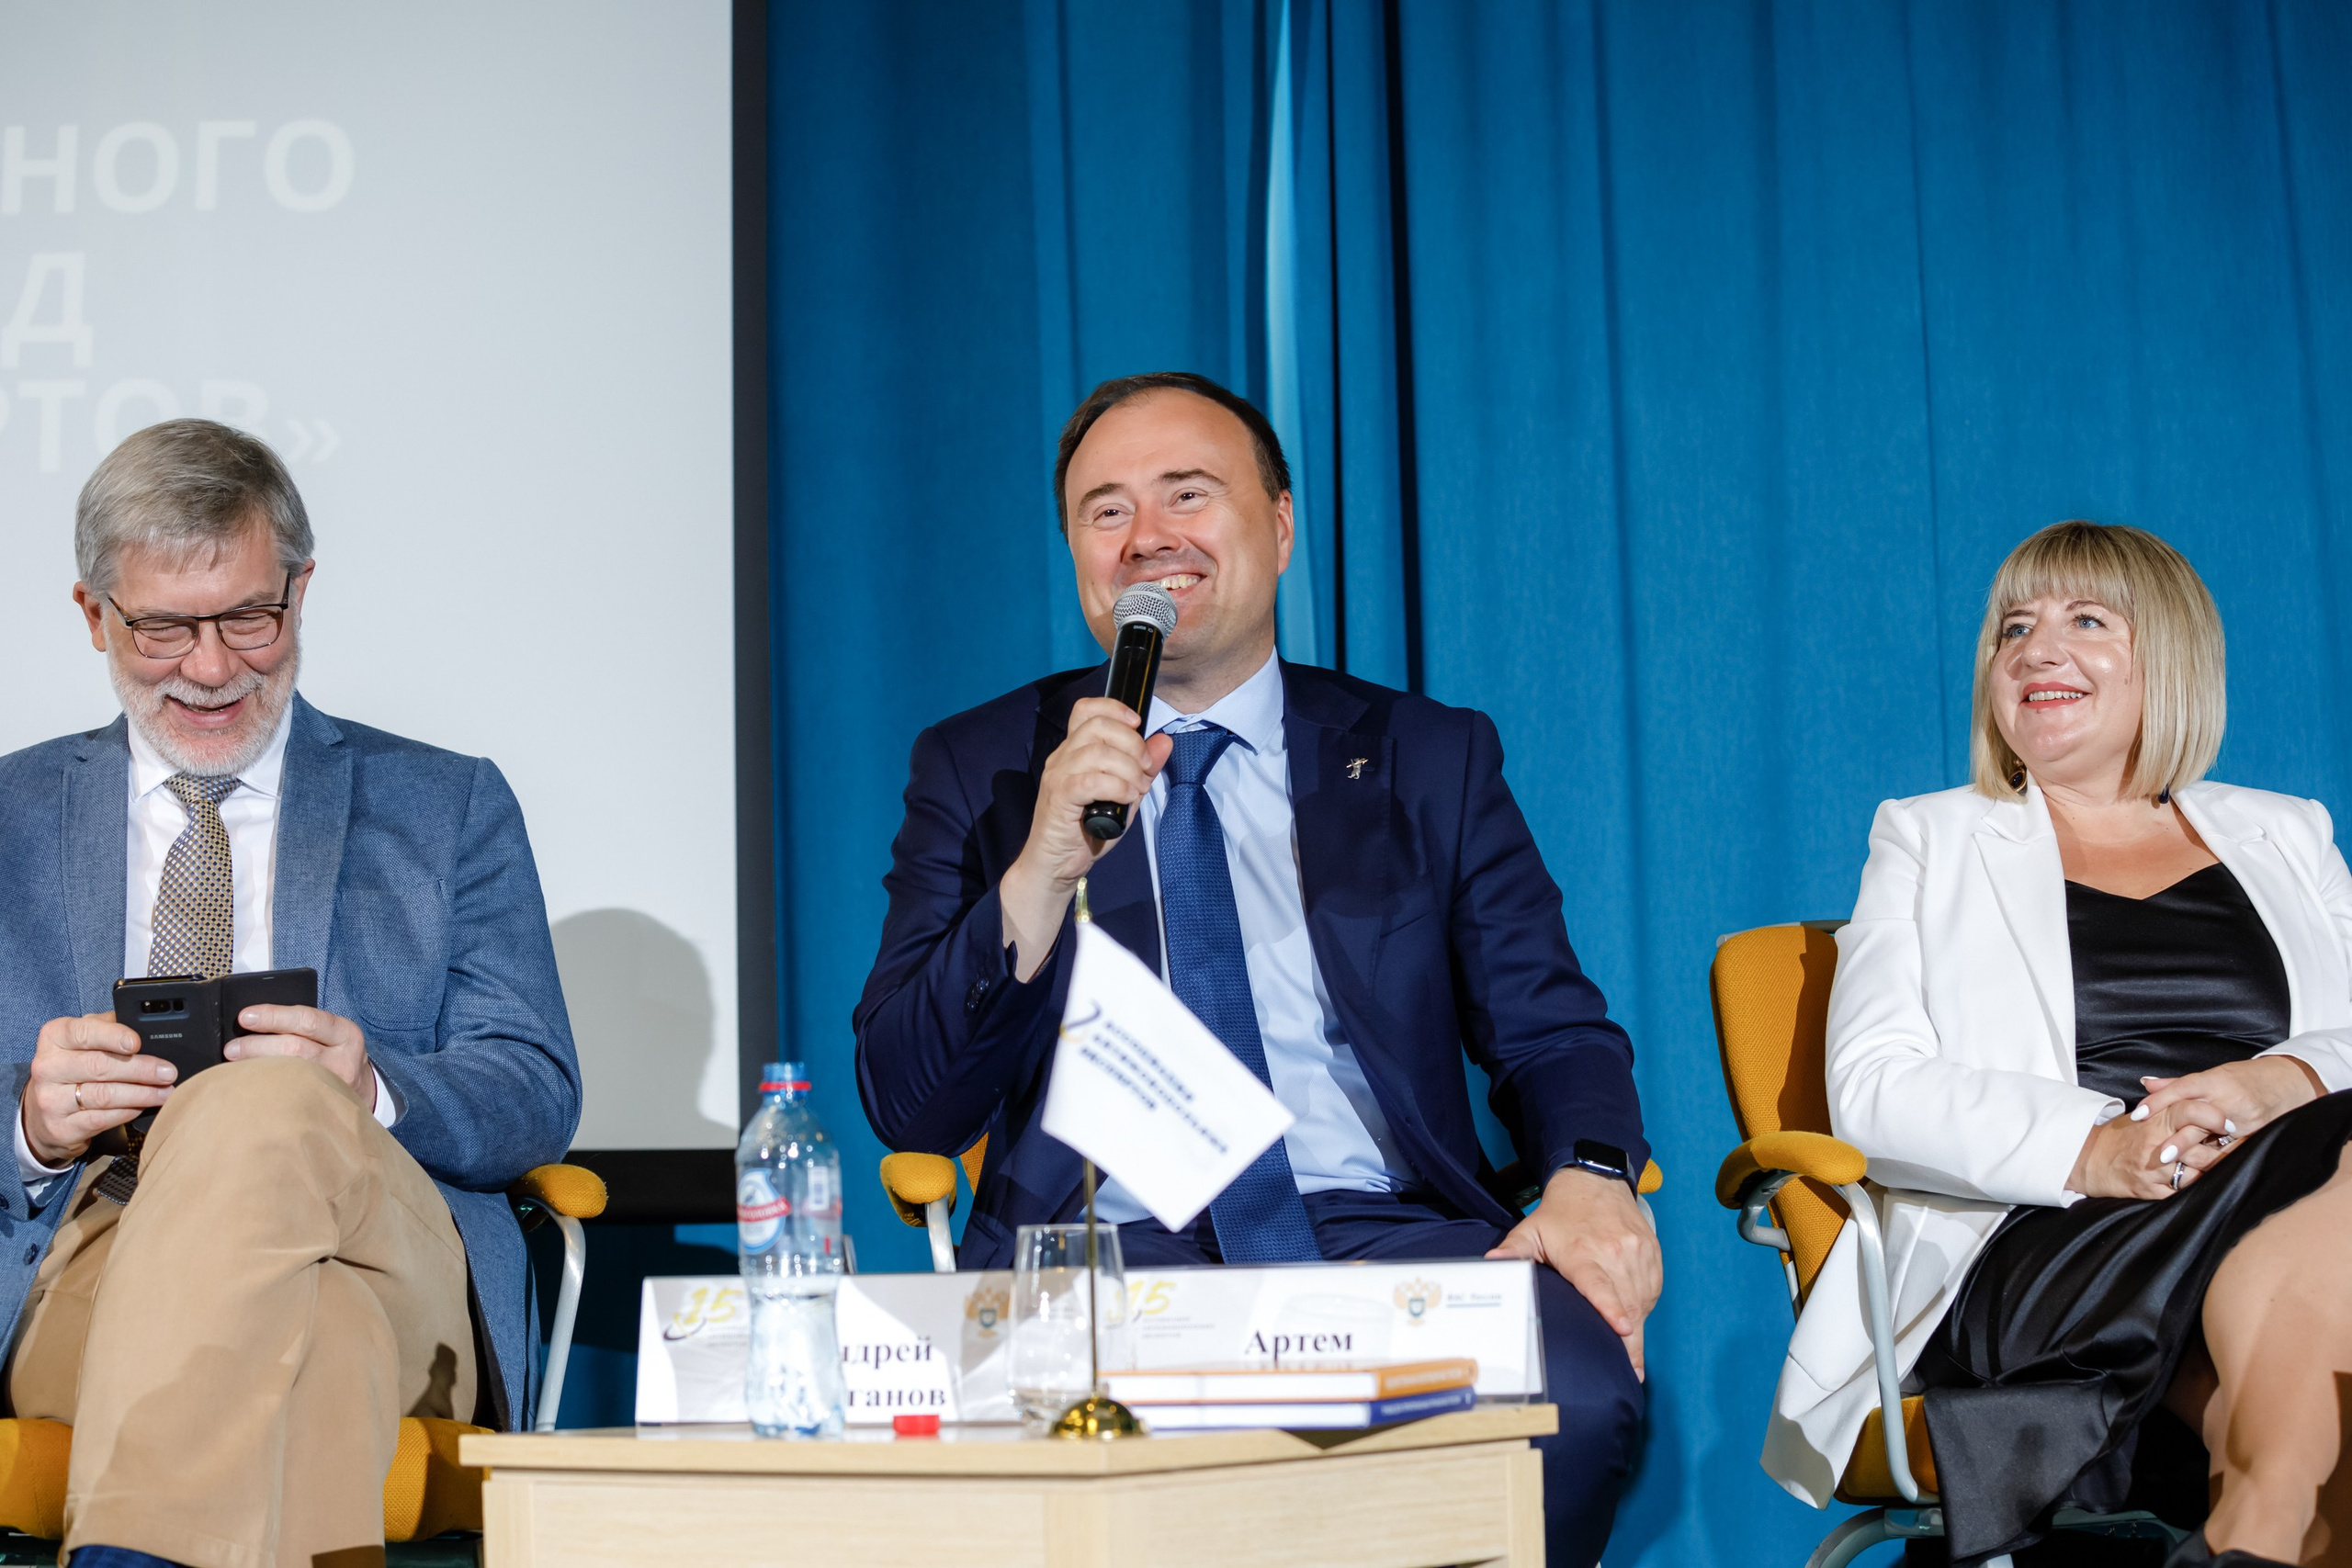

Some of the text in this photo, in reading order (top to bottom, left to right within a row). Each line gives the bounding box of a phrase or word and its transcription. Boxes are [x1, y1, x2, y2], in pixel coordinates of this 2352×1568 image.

[2, 118, 356, 216] НОГО
[1245, 1329, 1351, 1368] Артем
[848, 1390, 945, 1406] ганов
